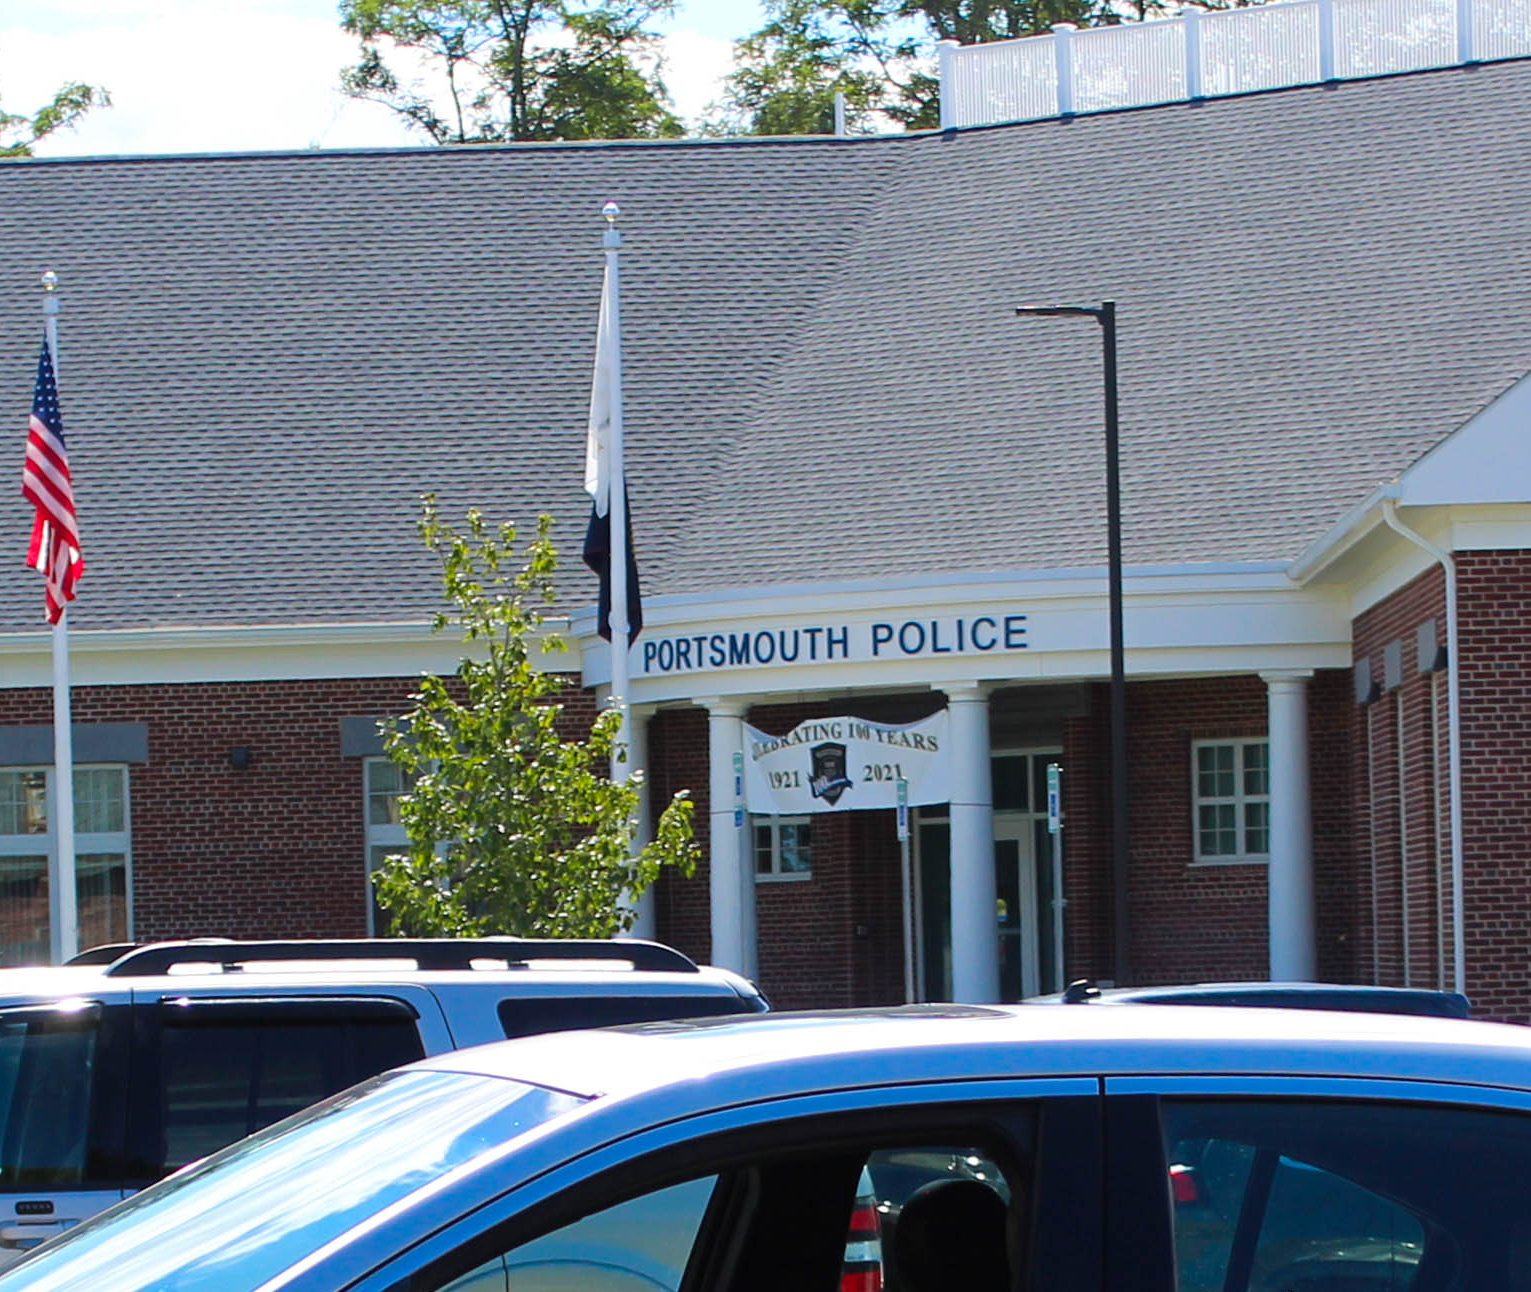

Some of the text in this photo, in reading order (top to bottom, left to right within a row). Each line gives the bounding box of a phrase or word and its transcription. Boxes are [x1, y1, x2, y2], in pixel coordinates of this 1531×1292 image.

[643, 615, 1028, 672] PORTSMOUTH POLICE
[876, 727, 939, 752] YEARS
[768, 770, 801, 789] 1921
[862, 763, 902, 782] 2021
